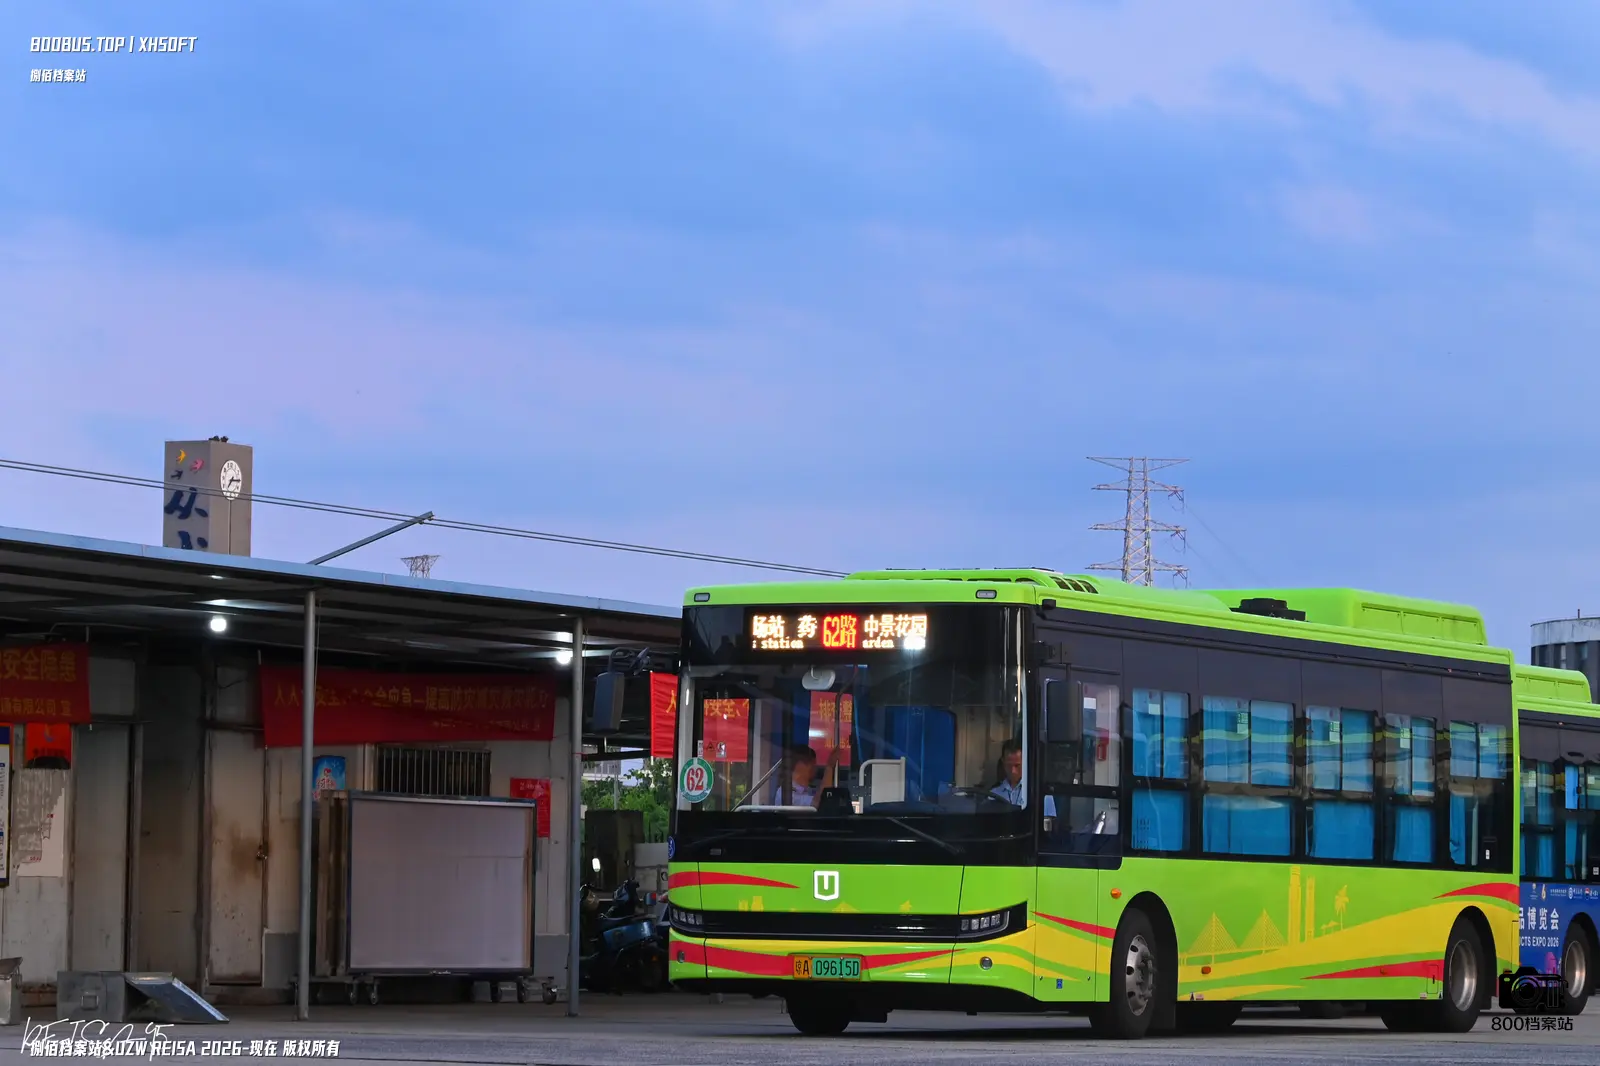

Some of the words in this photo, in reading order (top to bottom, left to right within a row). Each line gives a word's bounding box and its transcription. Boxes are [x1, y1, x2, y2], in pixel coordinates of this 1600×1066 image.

[823, 614, 857, 648] 62路
[864, 614, 928, 638] 中景花园
[687, 767, 704, 792] 62
[1532, 936, 1546, 947] EXPO
[1547, 937, 1559, 948] 2026
